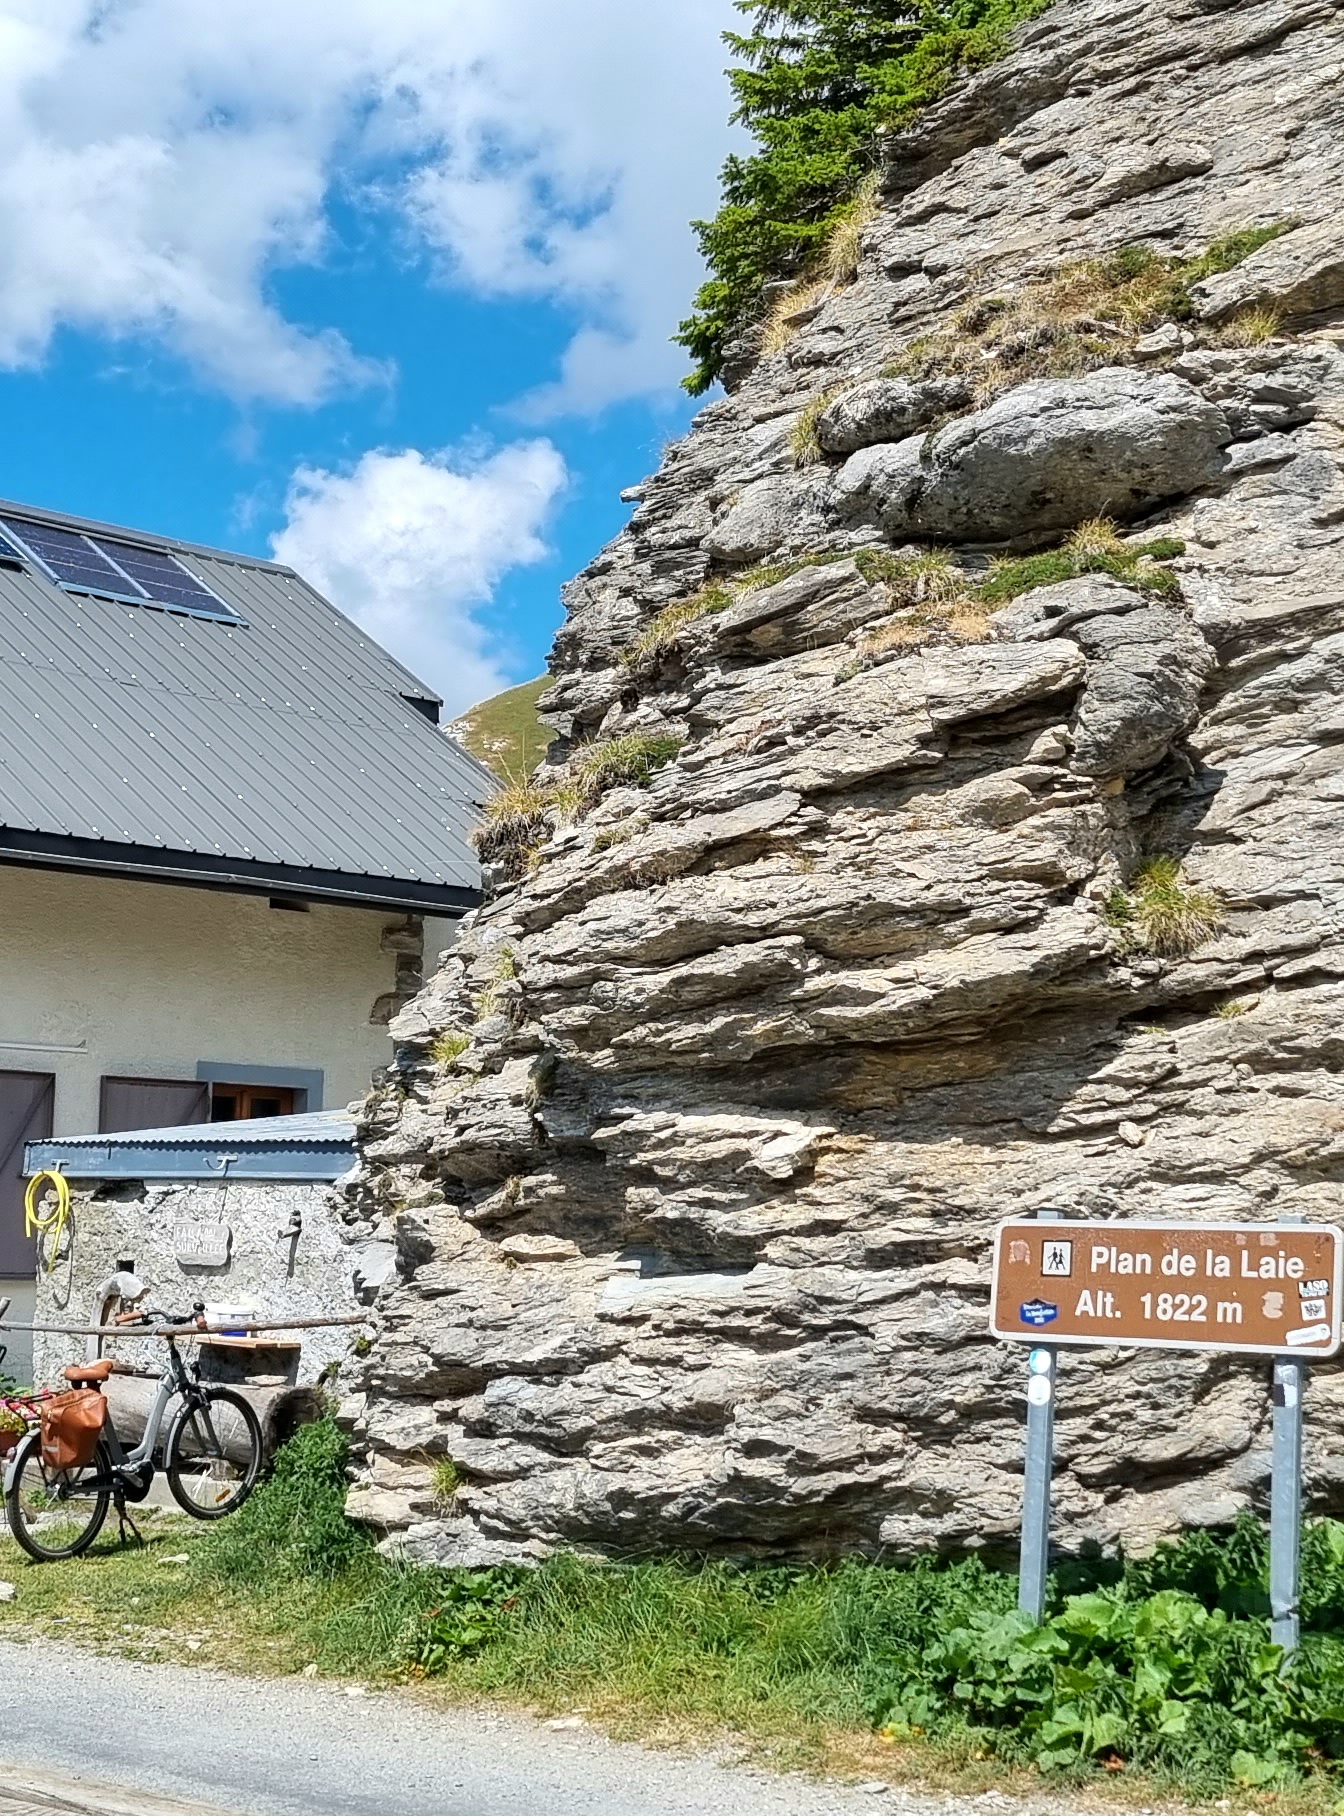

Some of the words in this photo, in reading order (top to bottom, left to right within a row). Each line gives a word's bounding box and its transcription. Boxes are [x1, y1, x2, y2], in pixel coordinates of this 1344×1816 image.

[1091, 1246, 1151, 1275] Plan
[1161, 1249, 1196, 1277] de
[1206, 1250, 1231, 1278] la
[1241, 1250, 1305, 1279] Laie
[1075, 1290, 1122, 1318] Alt.
[1140, 1292, 1206, 1321] 1822
[1217, 1300, 1243, 1324] m
